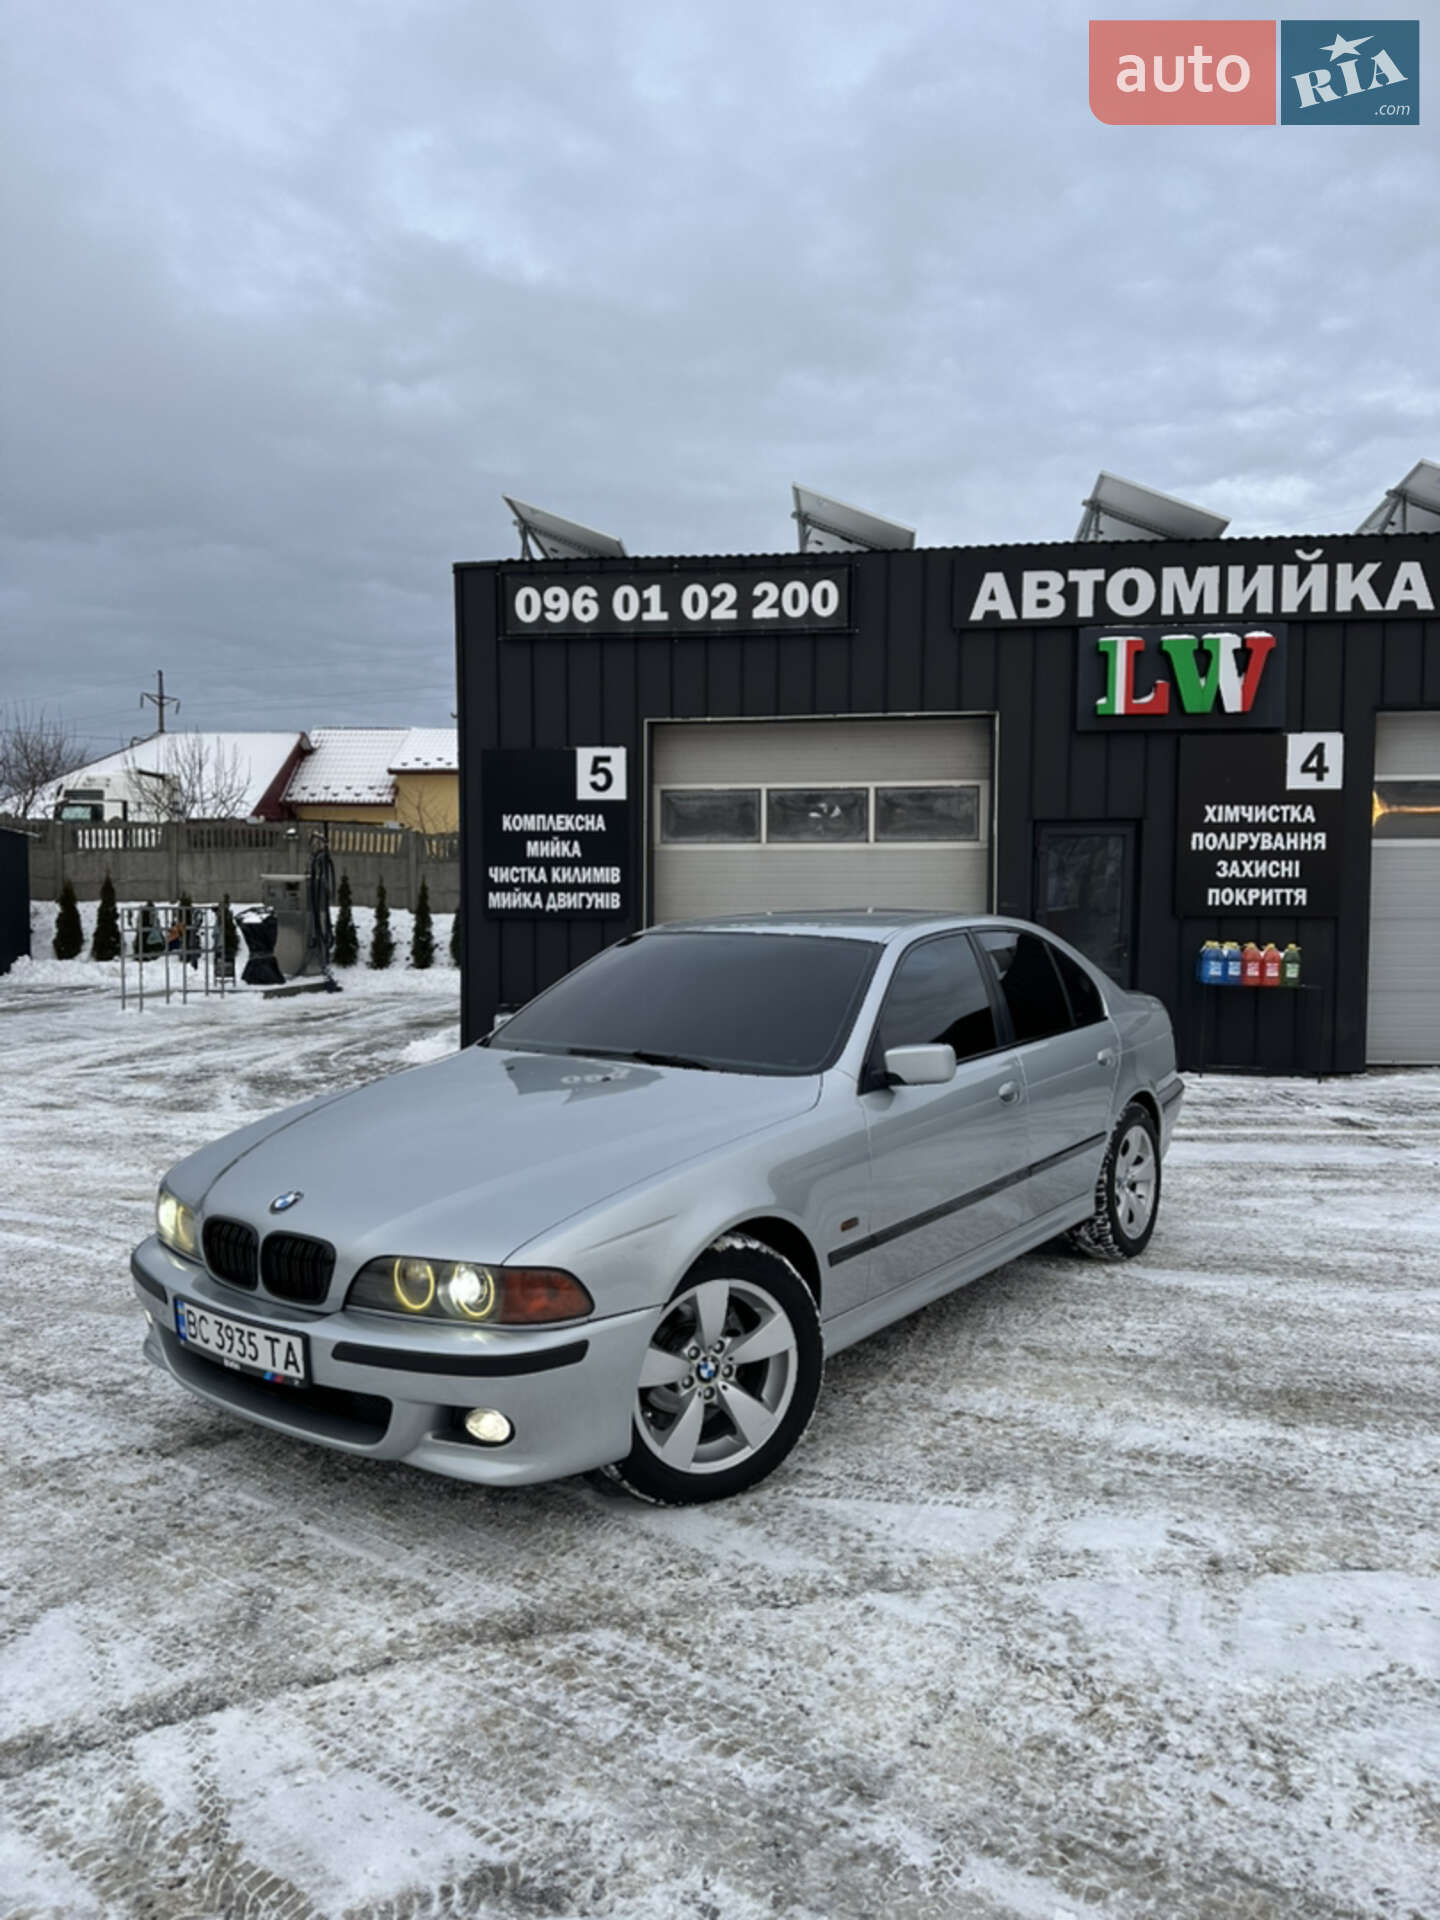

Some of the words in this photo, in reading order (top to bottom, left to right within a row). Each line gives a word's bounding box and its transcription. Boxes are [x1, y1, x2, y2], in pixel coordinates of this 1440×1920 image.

[969, 548, 1435, 621] АВТОМИЙКА
[514, 586, 599, 623] 096
[612, 584, 669, 621] 01
[681, 583, 737, 621] 02
[751, 580, 839, 619] 200
[1300, 742, 1329, 782] 4
[589, 755, 613, 793] 5
[502, 814, 606, 832] КОМПЛЕКСНА
[1203, 804, 1316, 823] ХІМЧИСТКА
[526, 836, 582, 858] МИЙКА
[1190, 832, 1327, 851] ПОЛІРУВАННЯ
[488, 866, 548, 884] ЧИСТКА
[551, 866, 621, 884] КИЛИМІВ
[1215, 859, 1300, 878] ЗАХИСНІ
[488, 887, 543, 909] МИЙКА
[545, 892, 621, 912] ДВИГУНІВ
[1207, 887, 1307, 906] ПОКРИТТЯ
[186, 1309, 210, 1344] BC
[214, 1319, 259, 1362] 3935
[263, 1334, 301, 1374] TA
